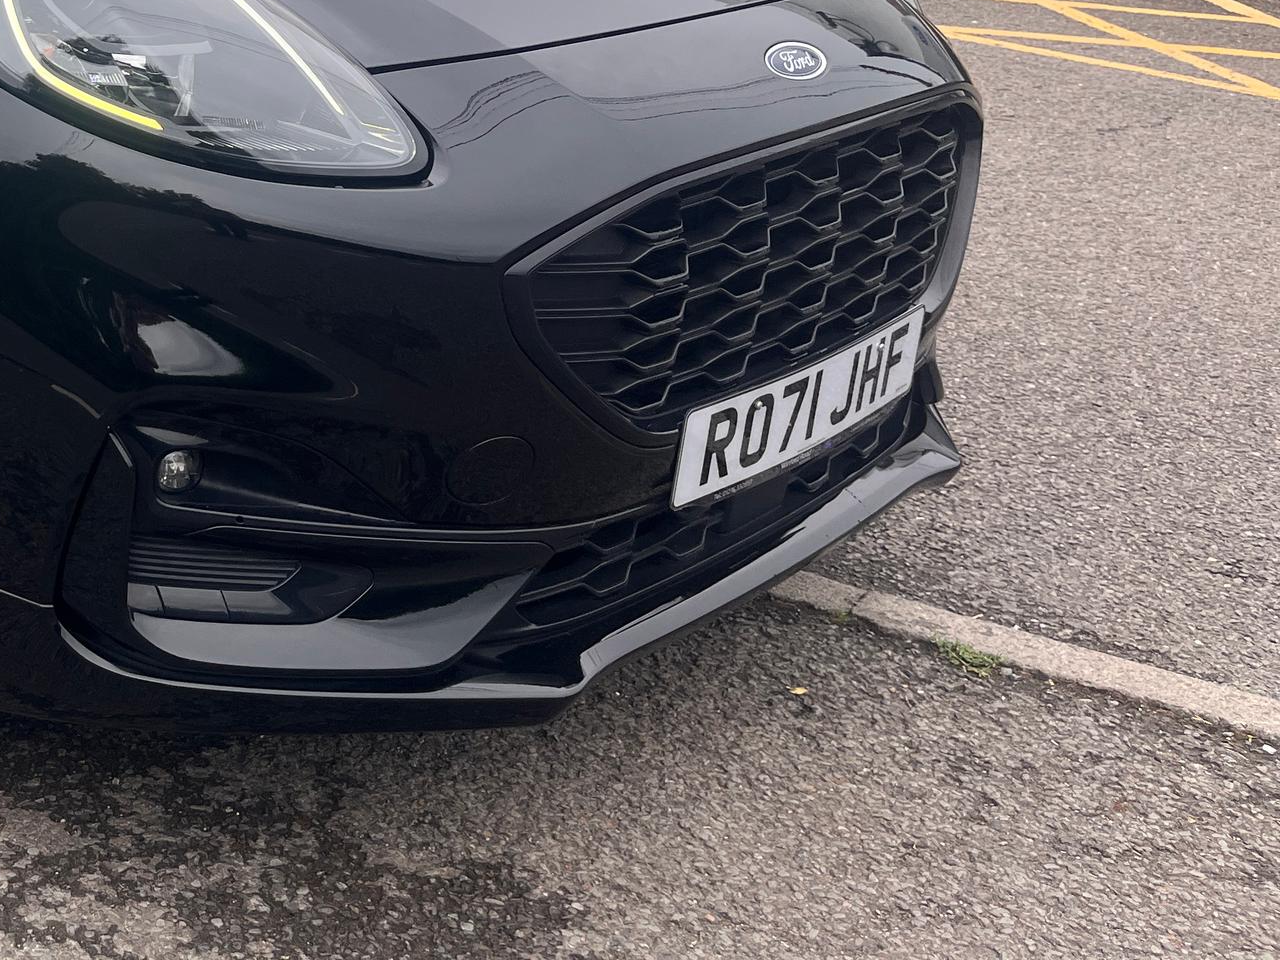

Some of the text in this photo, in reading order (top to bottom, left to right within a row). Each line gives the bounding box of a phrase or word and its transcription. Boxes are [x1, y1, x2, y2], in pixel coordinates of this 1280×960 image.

[778, 49, 815, 73] Ford
[699, 322, 910, 487] RO71 JHF
